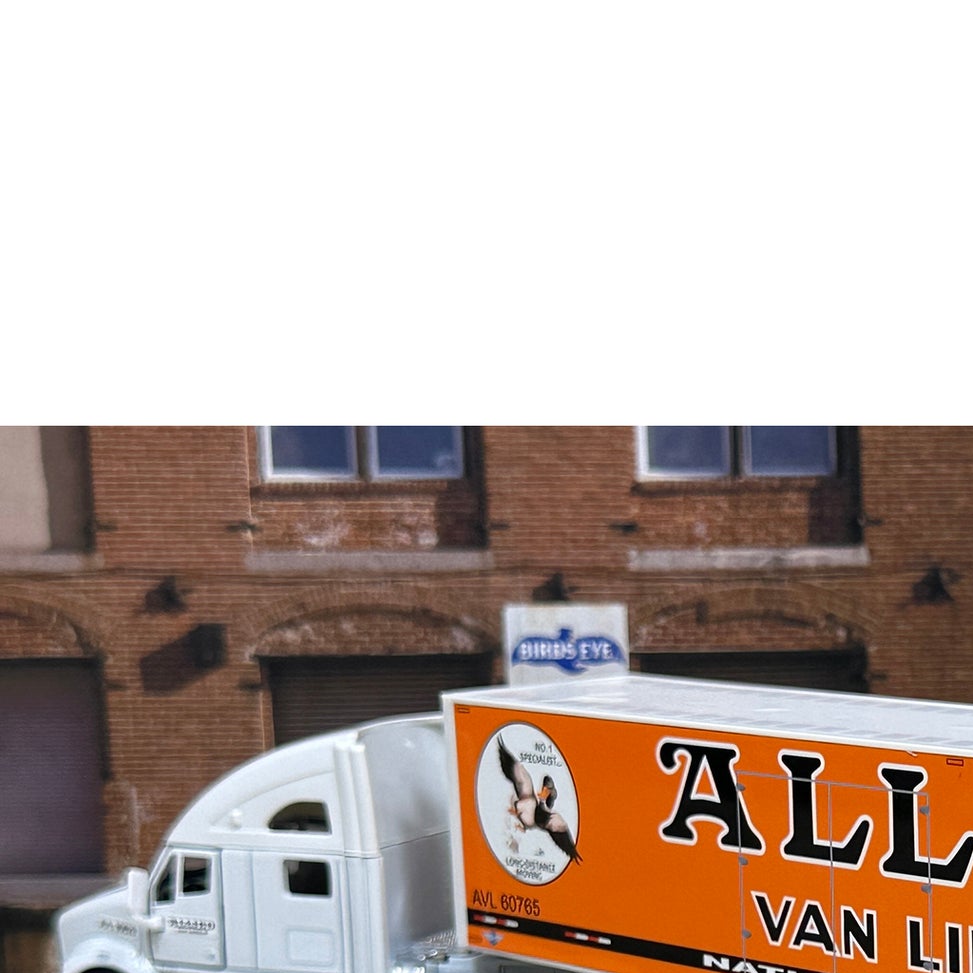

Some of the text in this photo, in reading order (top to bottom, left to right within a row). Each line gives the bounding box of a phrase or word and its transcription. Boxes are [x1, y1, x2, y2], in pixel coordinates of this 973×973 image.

[473, 889, 541, 917] AVL 60765
[752, 891, 878, 964] VAN
